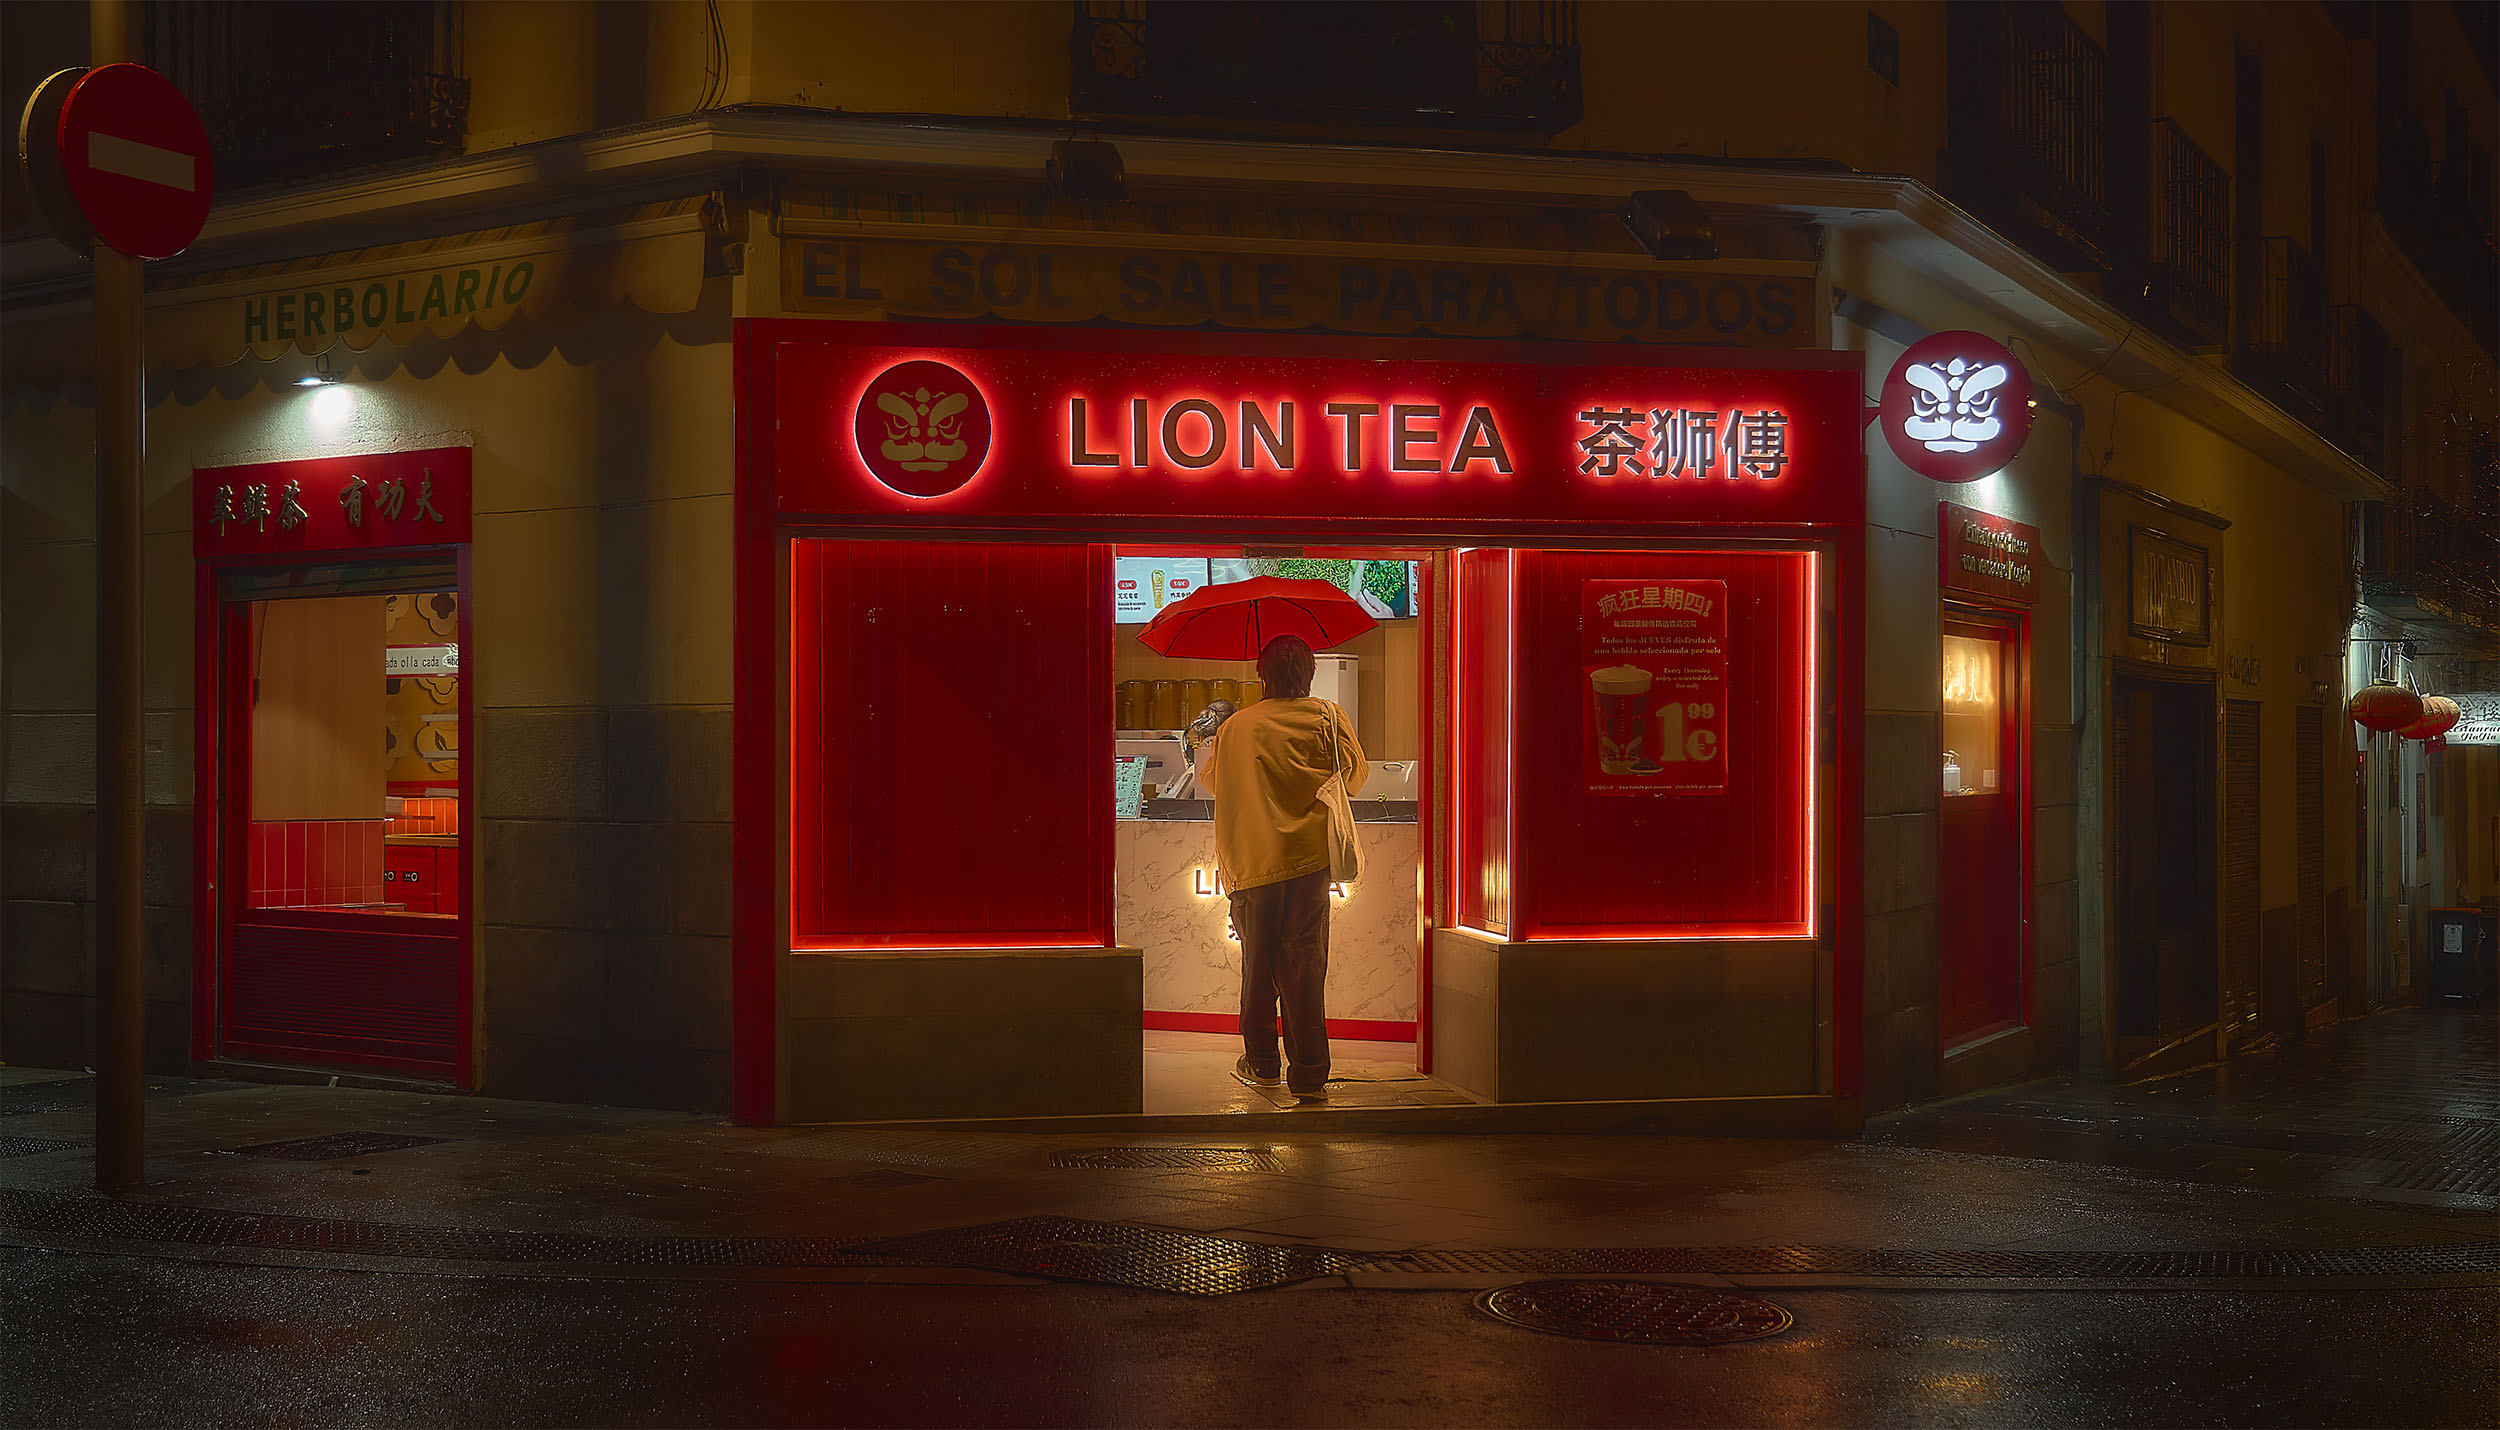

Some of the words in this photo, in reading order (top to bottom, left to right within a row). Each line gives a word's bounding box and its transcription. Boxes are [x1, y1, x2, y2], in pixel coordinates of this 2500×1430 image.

[244, 261, 535, 344] HERBOLARIO
[802, 242, 882, 300] EL
[929, 247, 1073, 307] SOL
[1119, 256, 1293, 317] SALE
[1339, 266, 1528, 323] PARA
[1561, 276, 1794, 335] TODOS
[1069, 397, 1295, 470] LION
[1325, 403, 1514, 475] TEA
[1576, 406, 1789, 480] 茶狮傅
[338, 467, 444, 528] 有功夫
[1597, 586, 1713, 618] 疯狂星期四!
[401, 655, 418, 668] olla
[423, 655, 439, 667] cada
[1601, 636, 1623, 644] Todos
[1625, 636, 1636, 644] los
[1639, 636, 1672, 644] JUEVES
[1674, 636, 1705, 644] disfruta
[1707, 636, 1717, 644] de
[1612, 646, 1638, 654] bebida
[1640, 646, 1689, 654] seleccionada
[1691, 647, 1704, 656] por
[1706, 646, 1721, 654] solo
